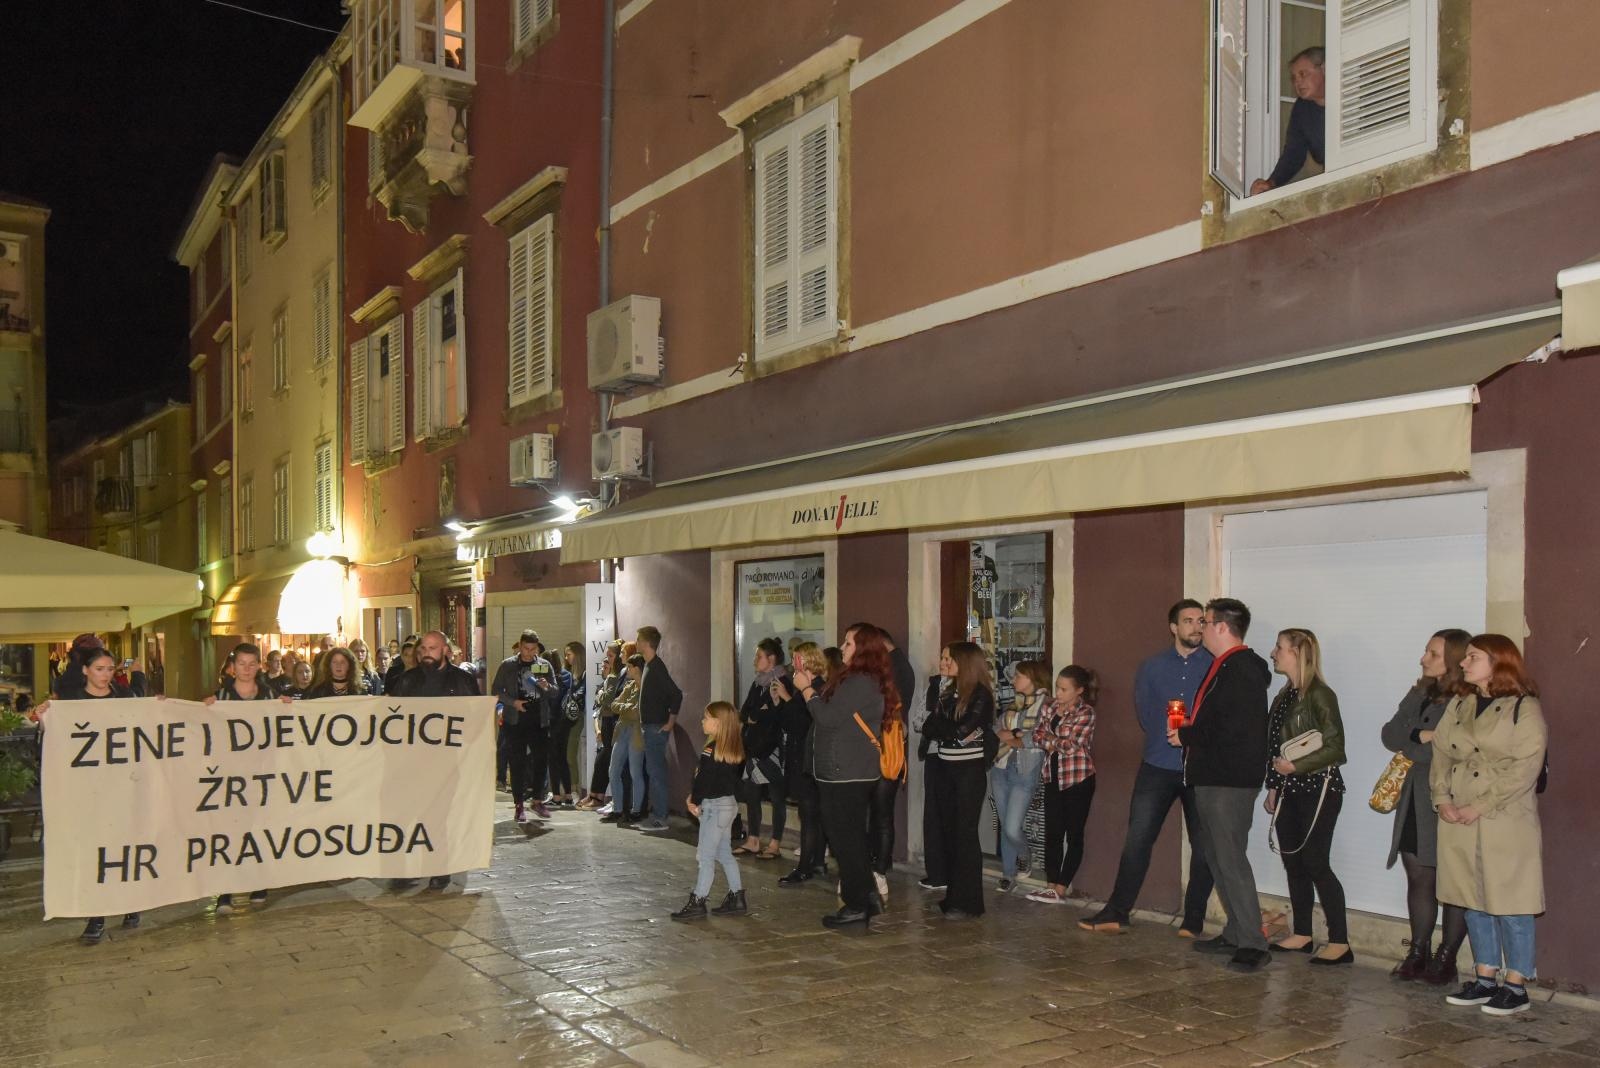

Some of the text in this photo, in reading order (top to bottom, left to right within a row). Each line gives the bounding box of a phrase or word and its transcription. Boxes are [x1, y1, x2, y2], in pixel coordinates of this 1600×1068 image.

[70, 704, 465, 768] ŽENE I DJEVOJČICE
[195, 765, 333, 812] ŽRTVE
[96, 821, 434, 884] HR PRAVOSUĐA
